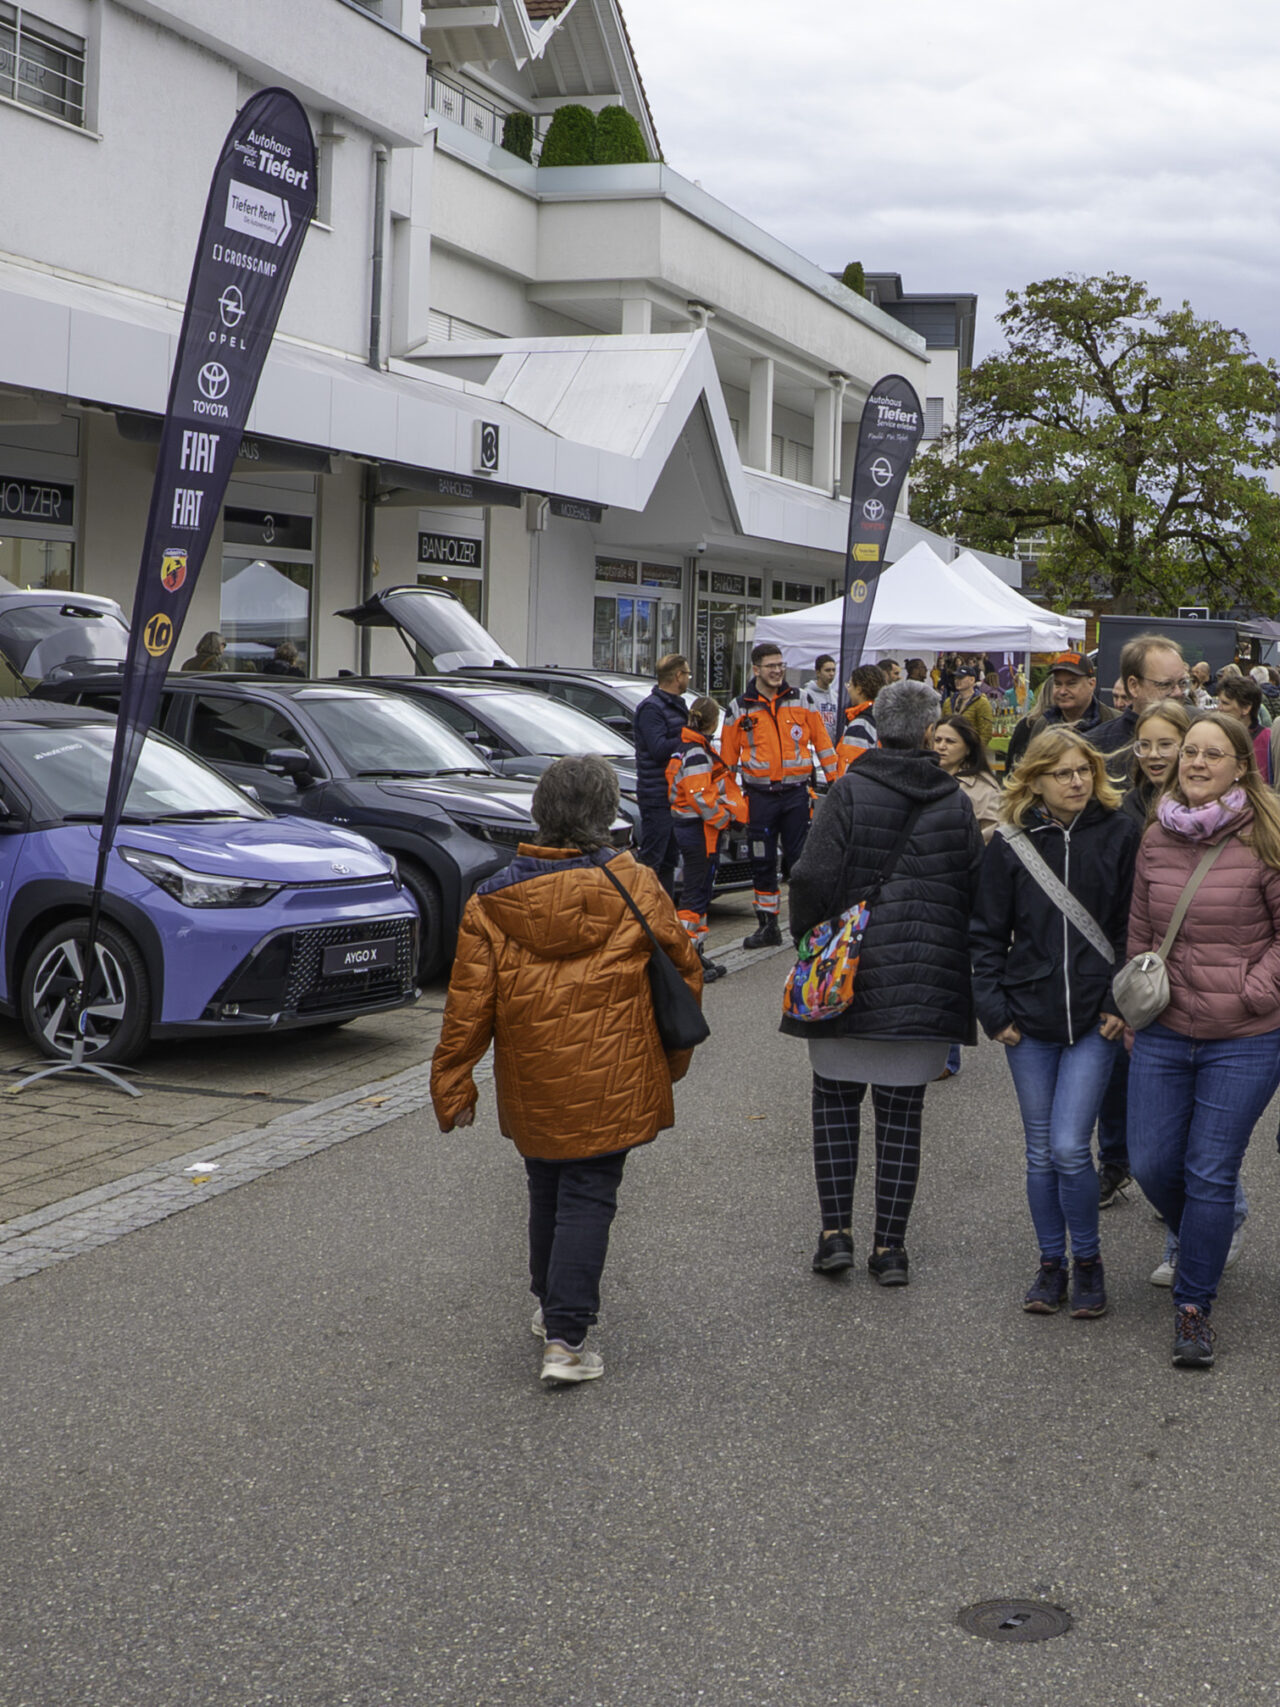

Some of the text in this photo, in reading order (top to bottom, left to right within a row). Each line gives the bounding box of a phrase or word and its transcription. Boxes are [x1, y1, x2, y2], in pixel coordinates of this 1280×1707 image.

[247, 129, 291, 158] Autohaus
[258, 149, 309, 191] Tiefert
[232, 195, 276, 223] Tiefert Rent
[224, 248, 277, 277] CROSSCAMP
[208, 331, 246, 350] OPEL
[192, 399, 229, 418] TOYOTA
[869, 395, 902, 407] Autohaus
[877, 406, 918, 424] Tiefert
[180, 430, 220, 474] FIAT
[171, 487, 204, 527] FIAT
[422, 536, 476, 564] BANHOLZER
[344, 948, 377, 965] AYGO X
